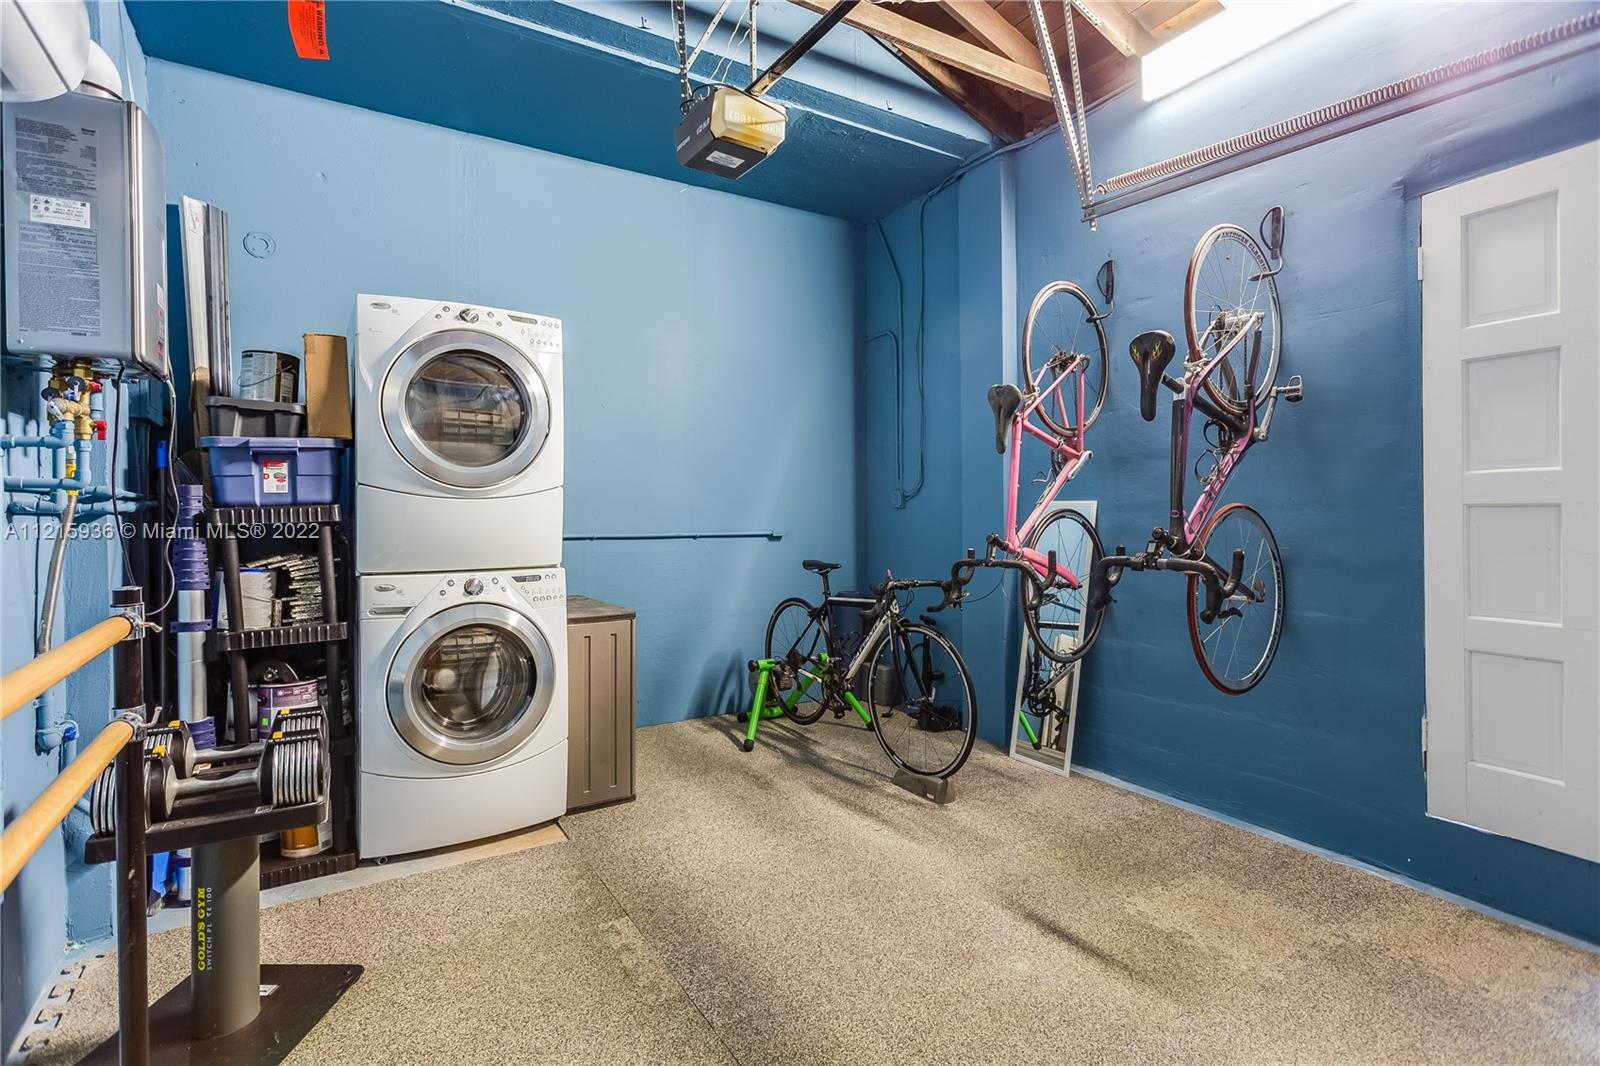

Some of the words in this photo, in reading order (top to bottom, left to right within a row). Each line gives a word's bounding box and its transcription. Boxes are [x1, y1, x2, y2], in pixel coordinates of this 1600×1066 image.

[316, 10, 325, 46] WARNING
[1248, 243, 1268, 272] CLASSIC
[198, 887, 206, 919] GYM
[197, 922, 205, 971] GOLD'S
